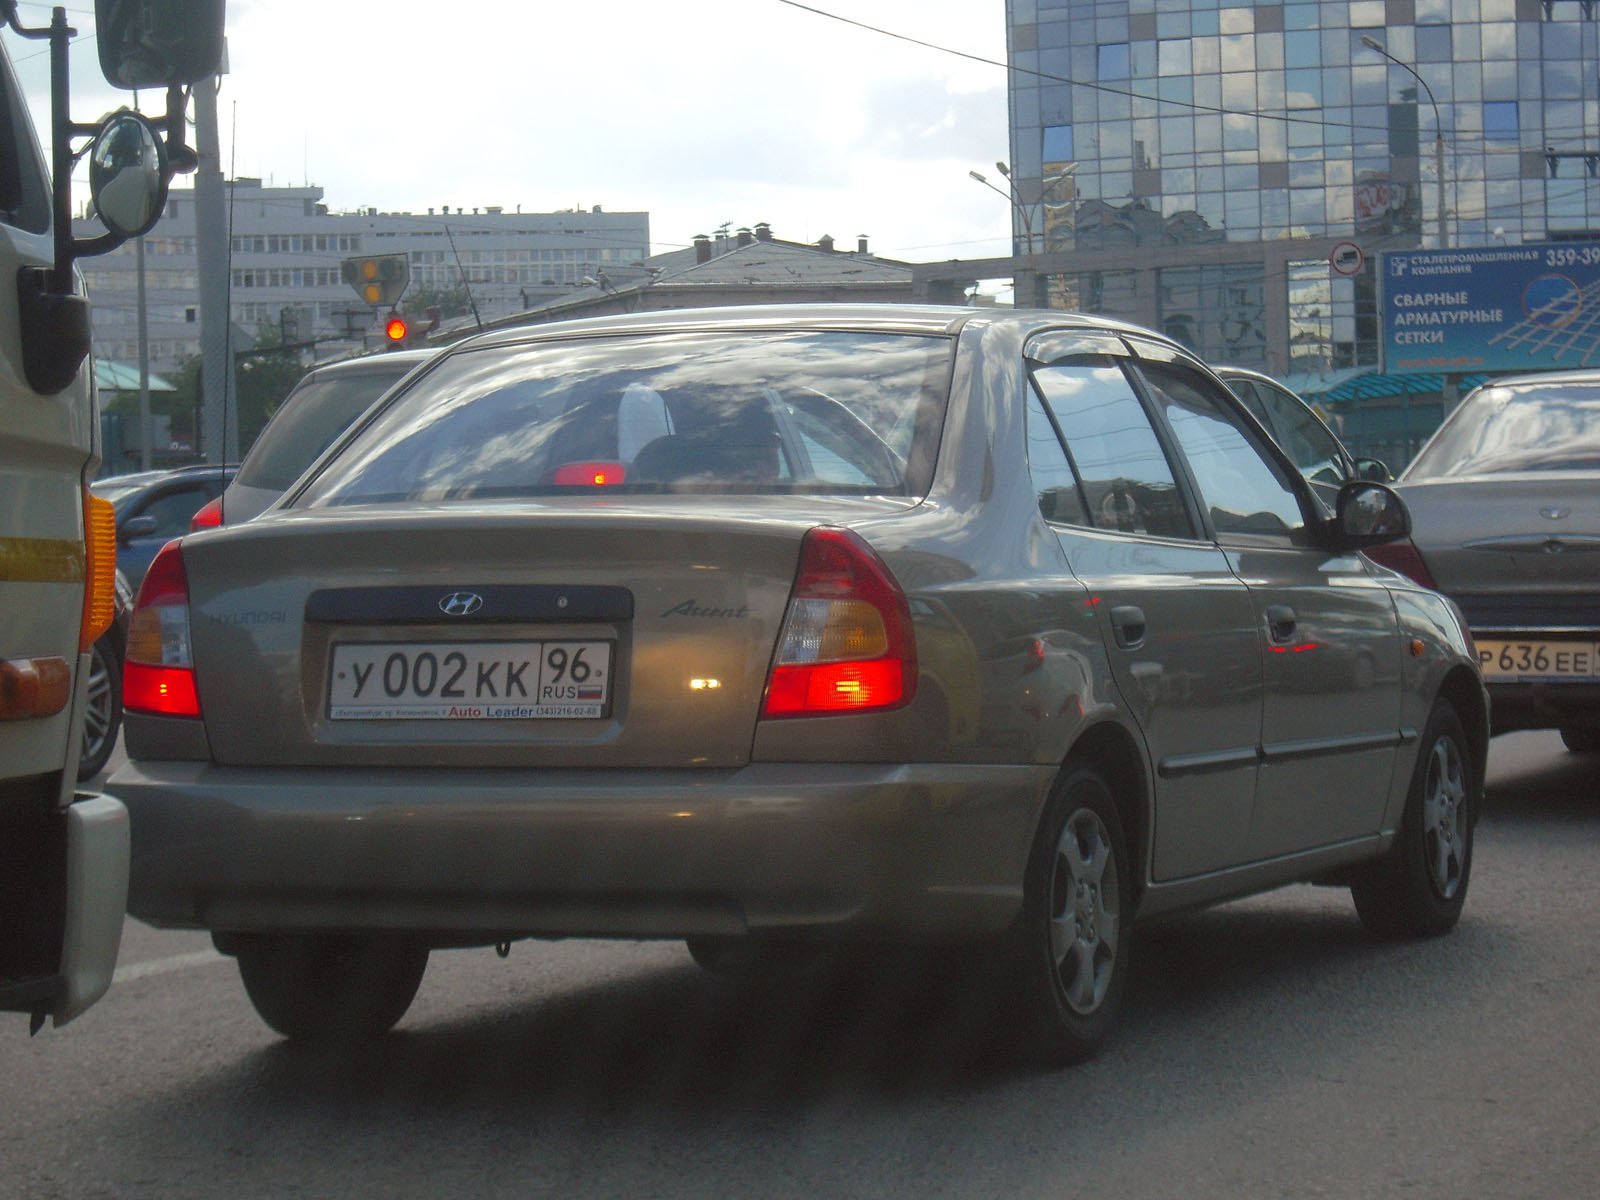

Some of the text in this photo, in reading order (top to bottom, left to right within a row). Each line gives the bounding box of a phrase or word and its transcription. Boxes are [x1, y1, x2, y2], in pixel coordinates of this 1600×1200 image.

[1411, 251, 1538, 265] СТАЛЕПРОМЫШЛЕННАЯ
[1411, 264, 1472, 276] КОМПАНИЯ
[1393, 292, 1468, 307] СВАРНЫЕ
[1394, 310, 1503, 326] АРМАТУРНЫЕ
[1394, 331, 1444, 345] СЕТКИ
[547, 648, 591, 684] 96
[543, 685, 576, 699] RUS
[449, 706, 481, 717] Auto
[486, 706, 533, 718] Leader
